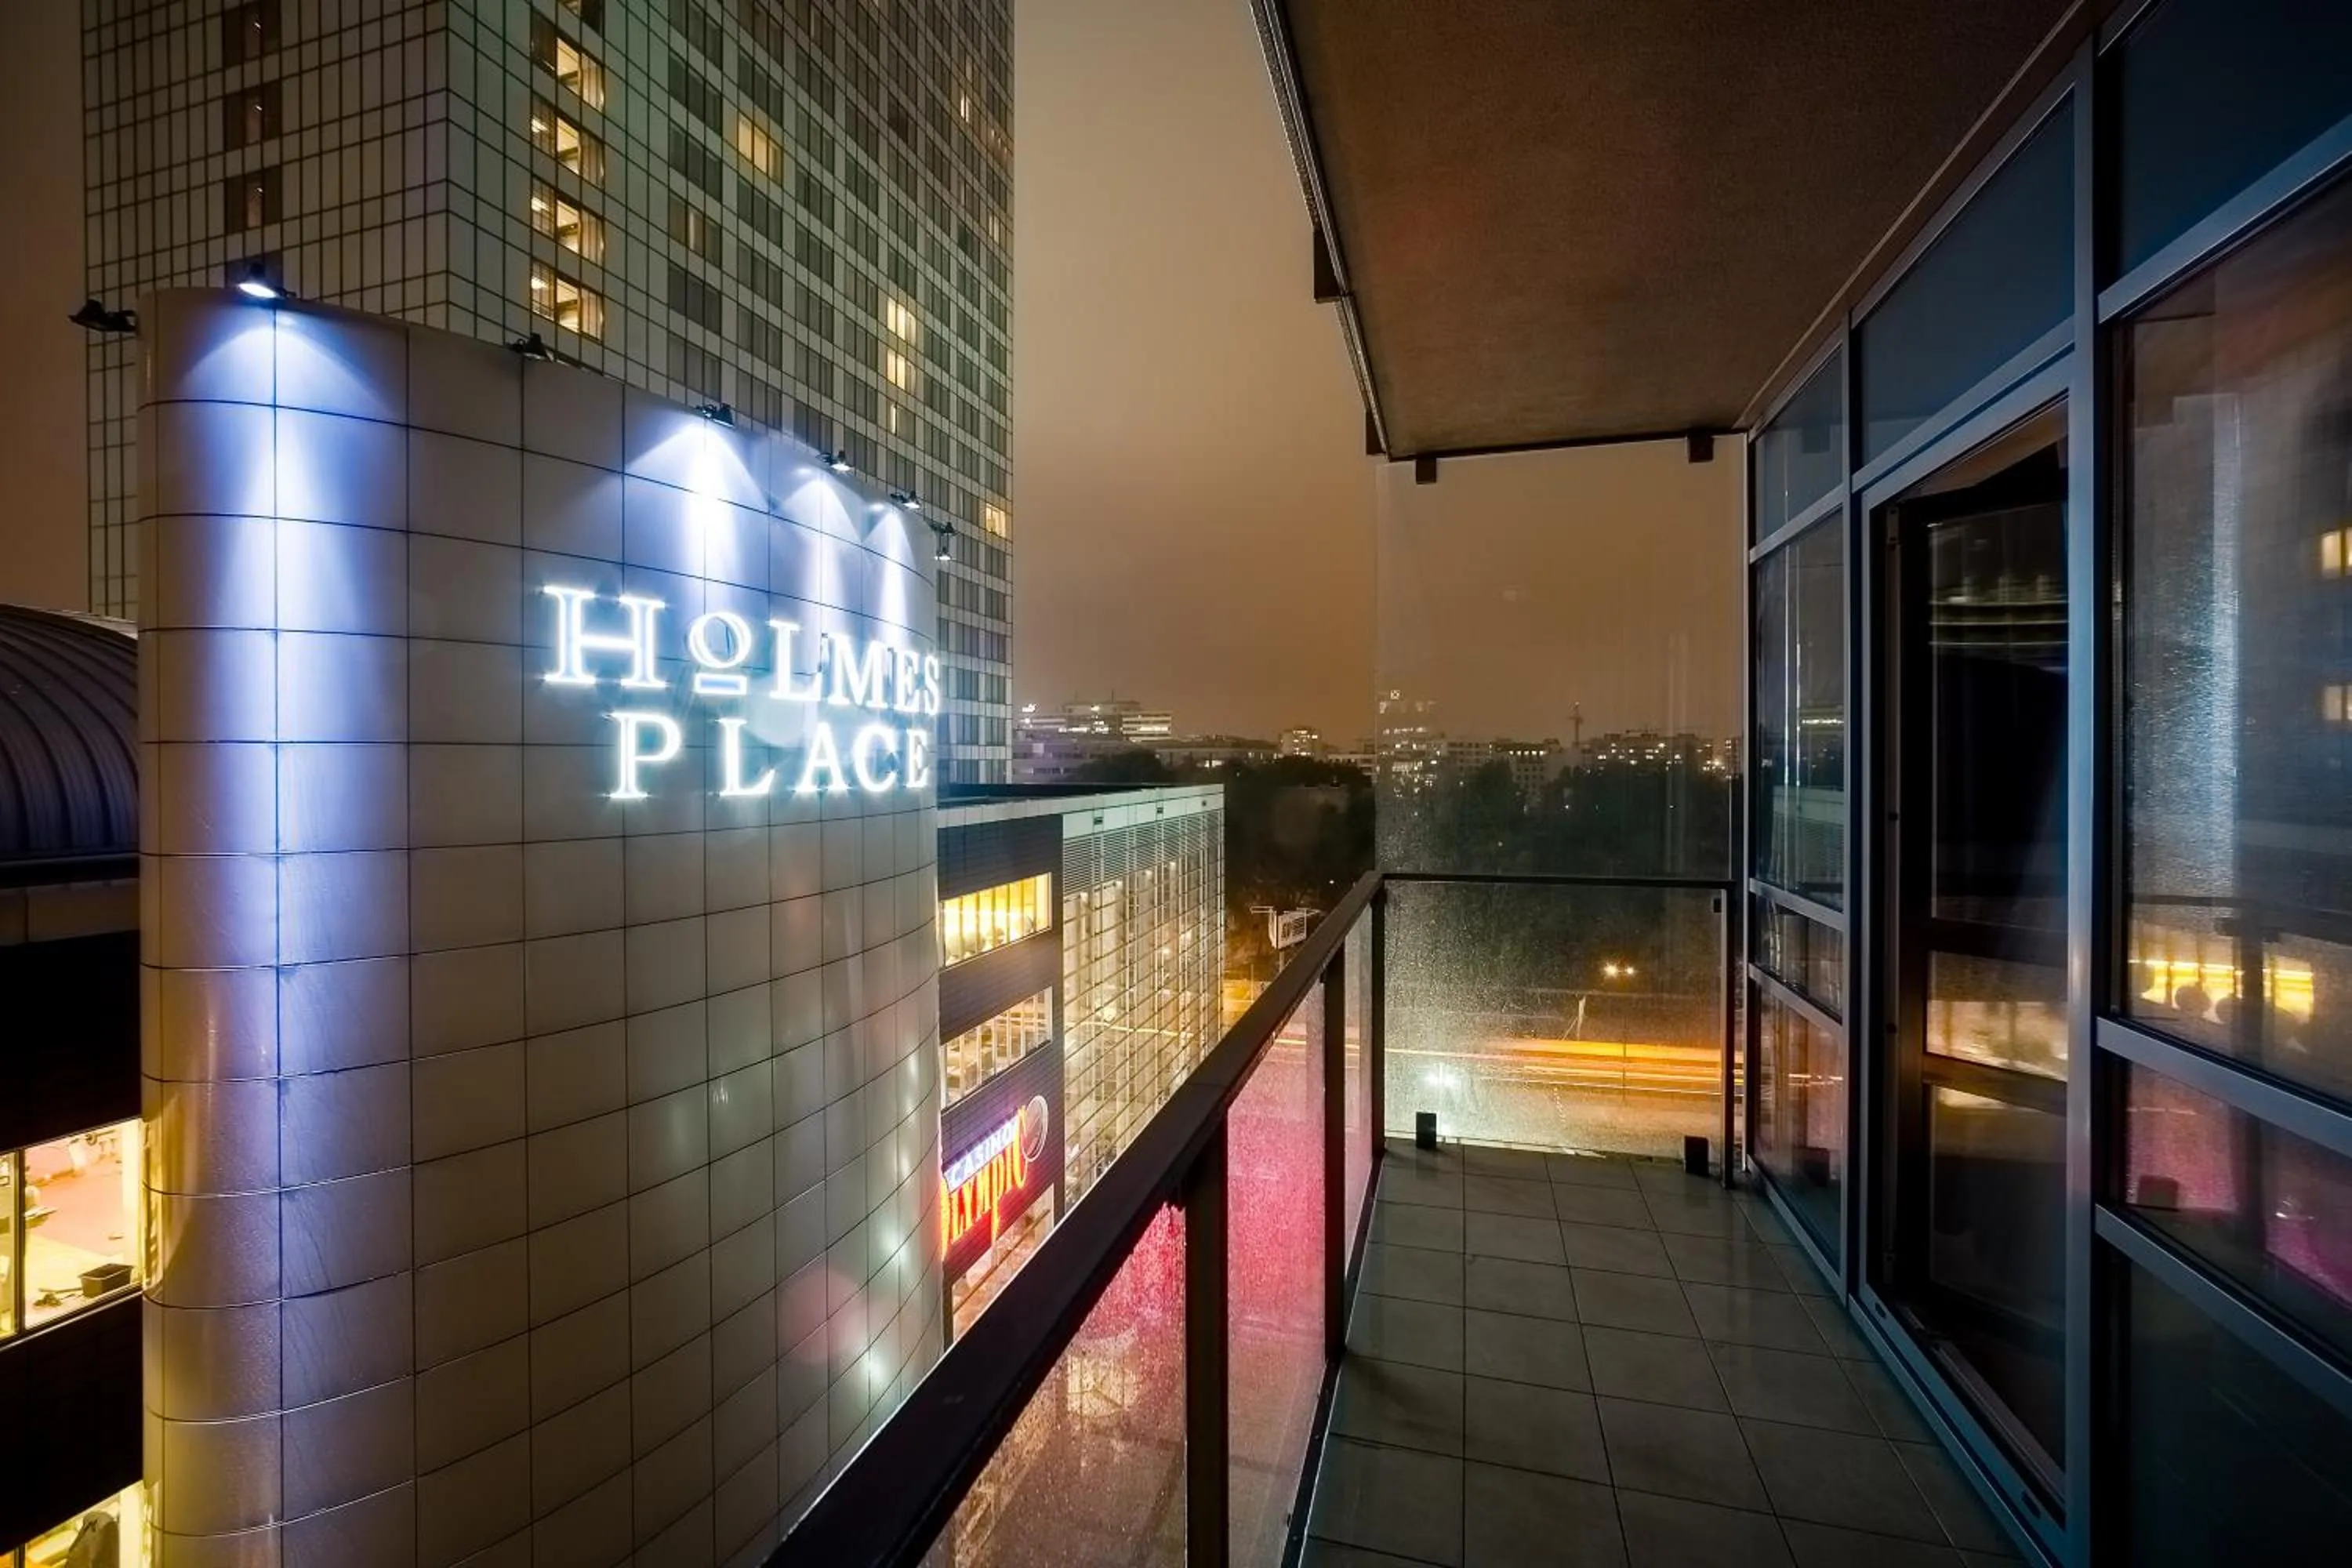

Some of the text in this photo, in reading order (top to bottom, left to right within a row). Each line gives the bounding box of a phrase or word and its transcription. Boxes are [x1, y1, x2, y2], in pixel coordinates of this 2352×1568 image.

[542, 584, 941, 715] HOLMES
[605, 711, 931, 800] PLACE
[949, 1120, 1015, 1185] CASINO
